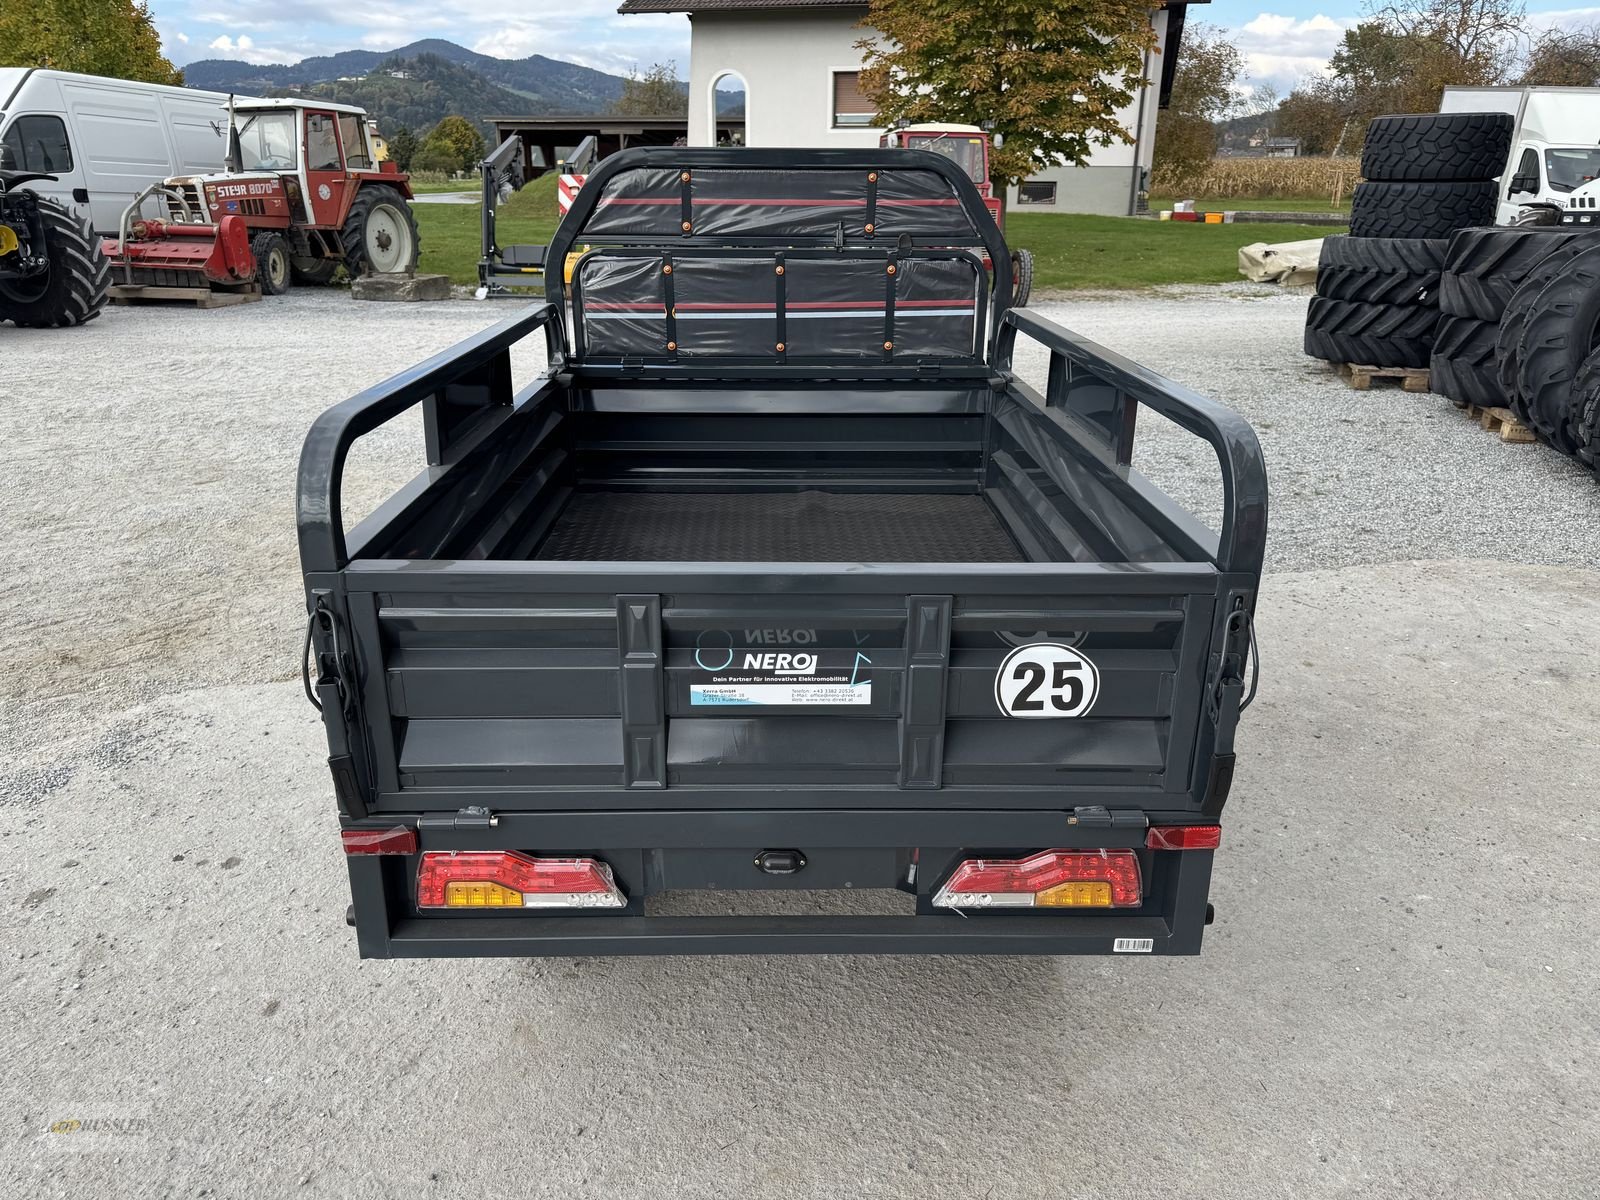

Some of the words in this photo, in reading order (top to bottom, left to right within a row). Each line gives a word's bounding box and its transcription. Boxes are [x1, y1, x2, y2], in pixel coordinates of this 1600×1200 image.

[217, 185, 247, 198] STEYR
[249, 183, 272, 195] 8070
[1011, 661, 1084, 711] 25
